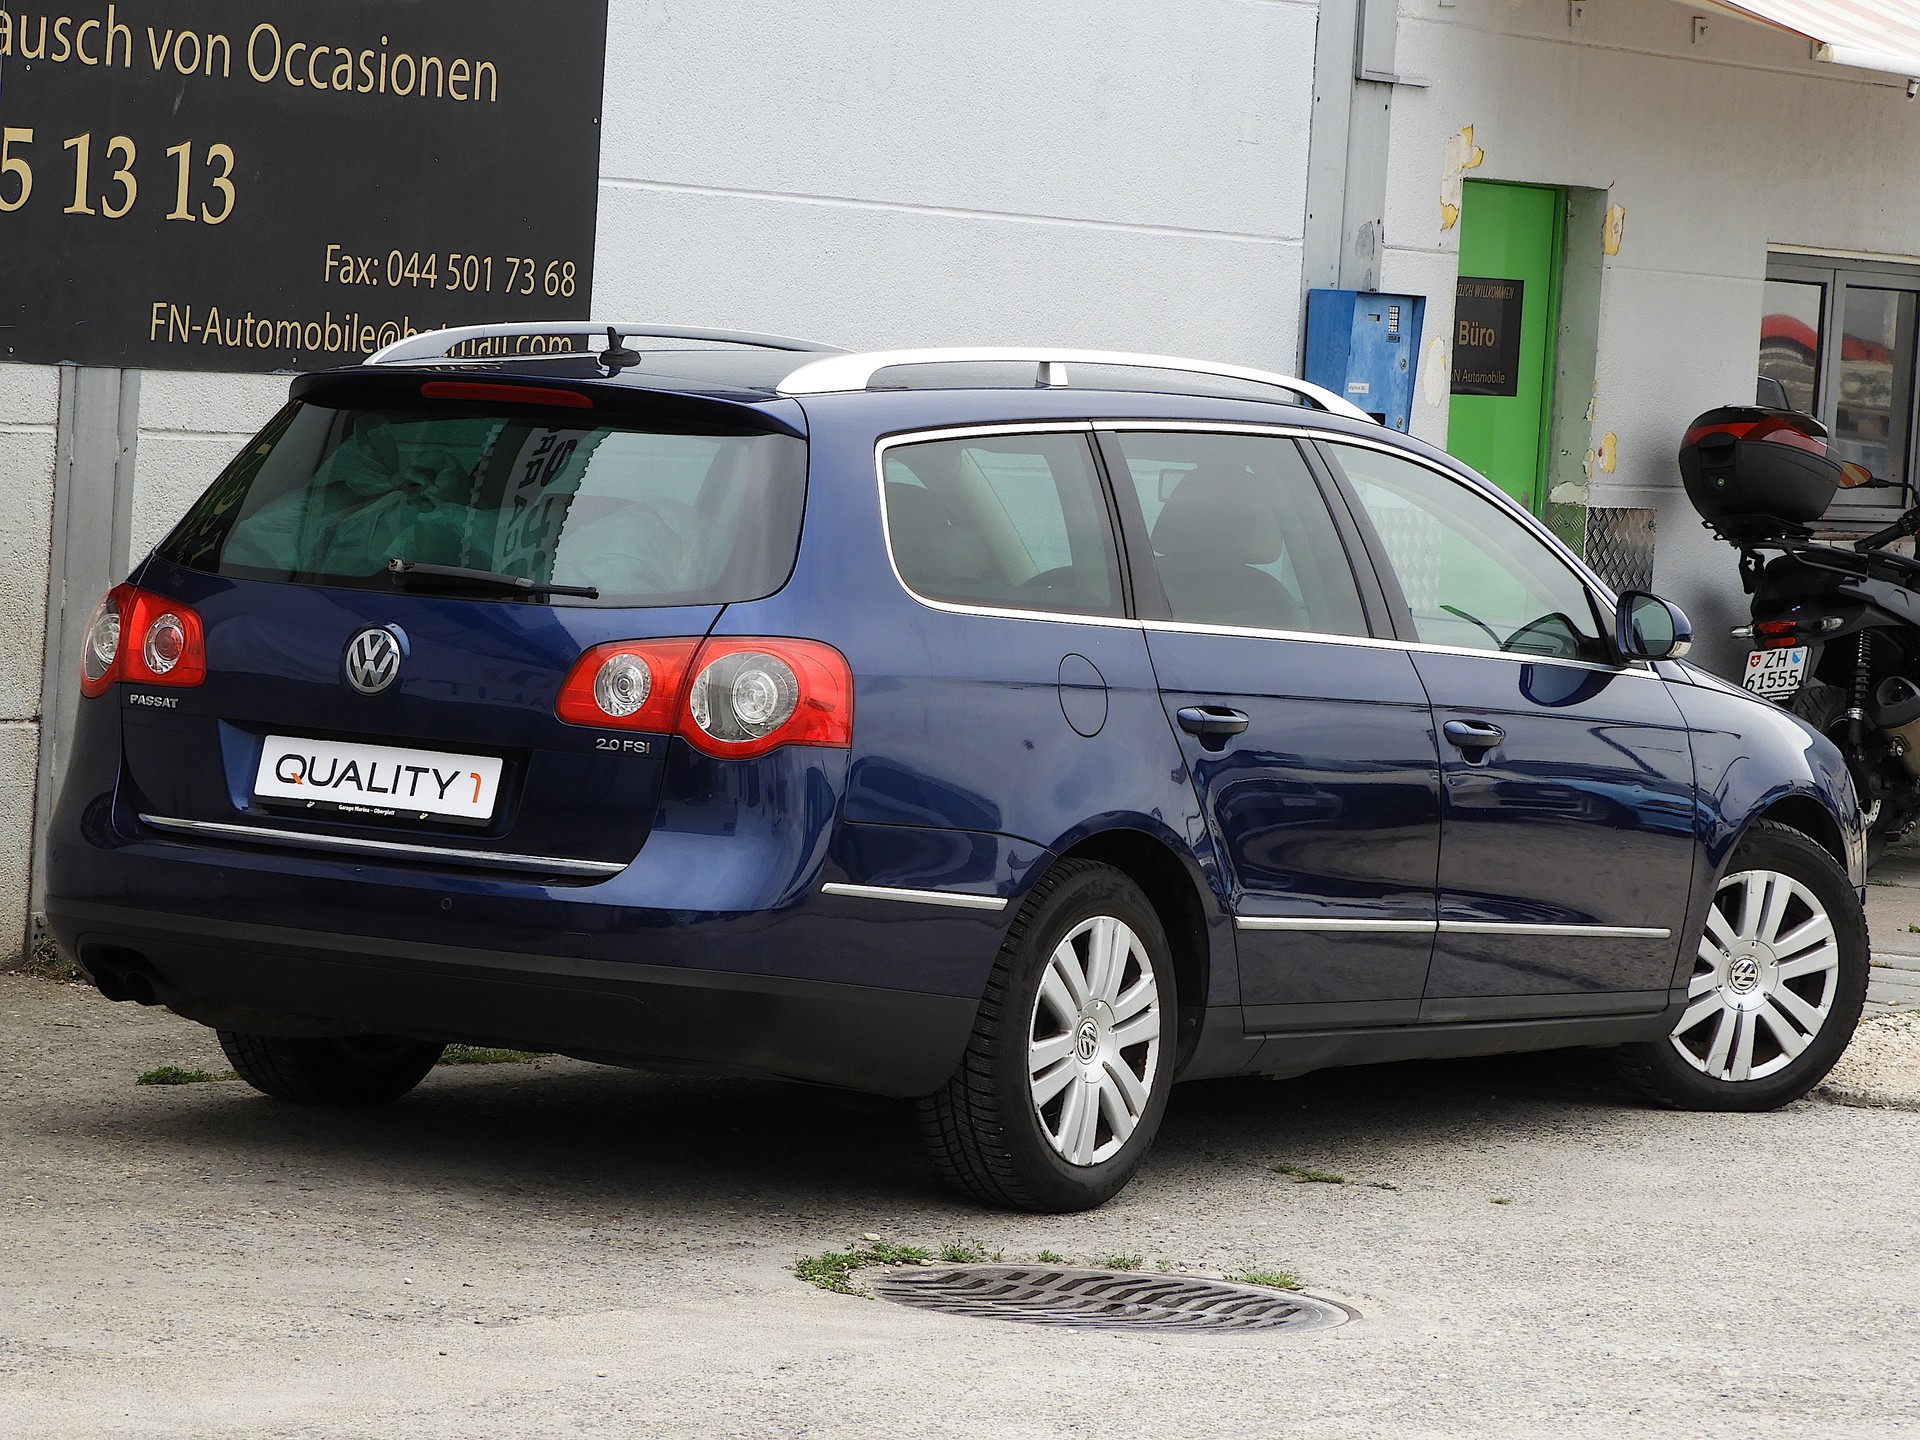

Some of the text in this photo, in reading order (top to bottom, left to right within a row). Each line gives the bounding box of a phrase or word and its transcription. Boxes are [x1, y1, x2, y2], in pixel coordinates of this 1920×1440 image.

[147, 27, 231, 78] von
[246, 23, 498, 103] Occasionen
[0, 127, 236, 225] 5 13 13
[324, 244, 576, 298] Fax: 044 501 73 68
[1474, 285, 1515, 300] WILLKOMMEN
[1458, 320, 1495, 347] Büro
[1461, 369, 1505, 384] Automobile
[1764, 650, 1789, 669] ZH
[1745, 669, 1799, 691] 61555
[129, 694, 179, 709] PASSAT
[275, 753, 482, 804] QUALITY 1
